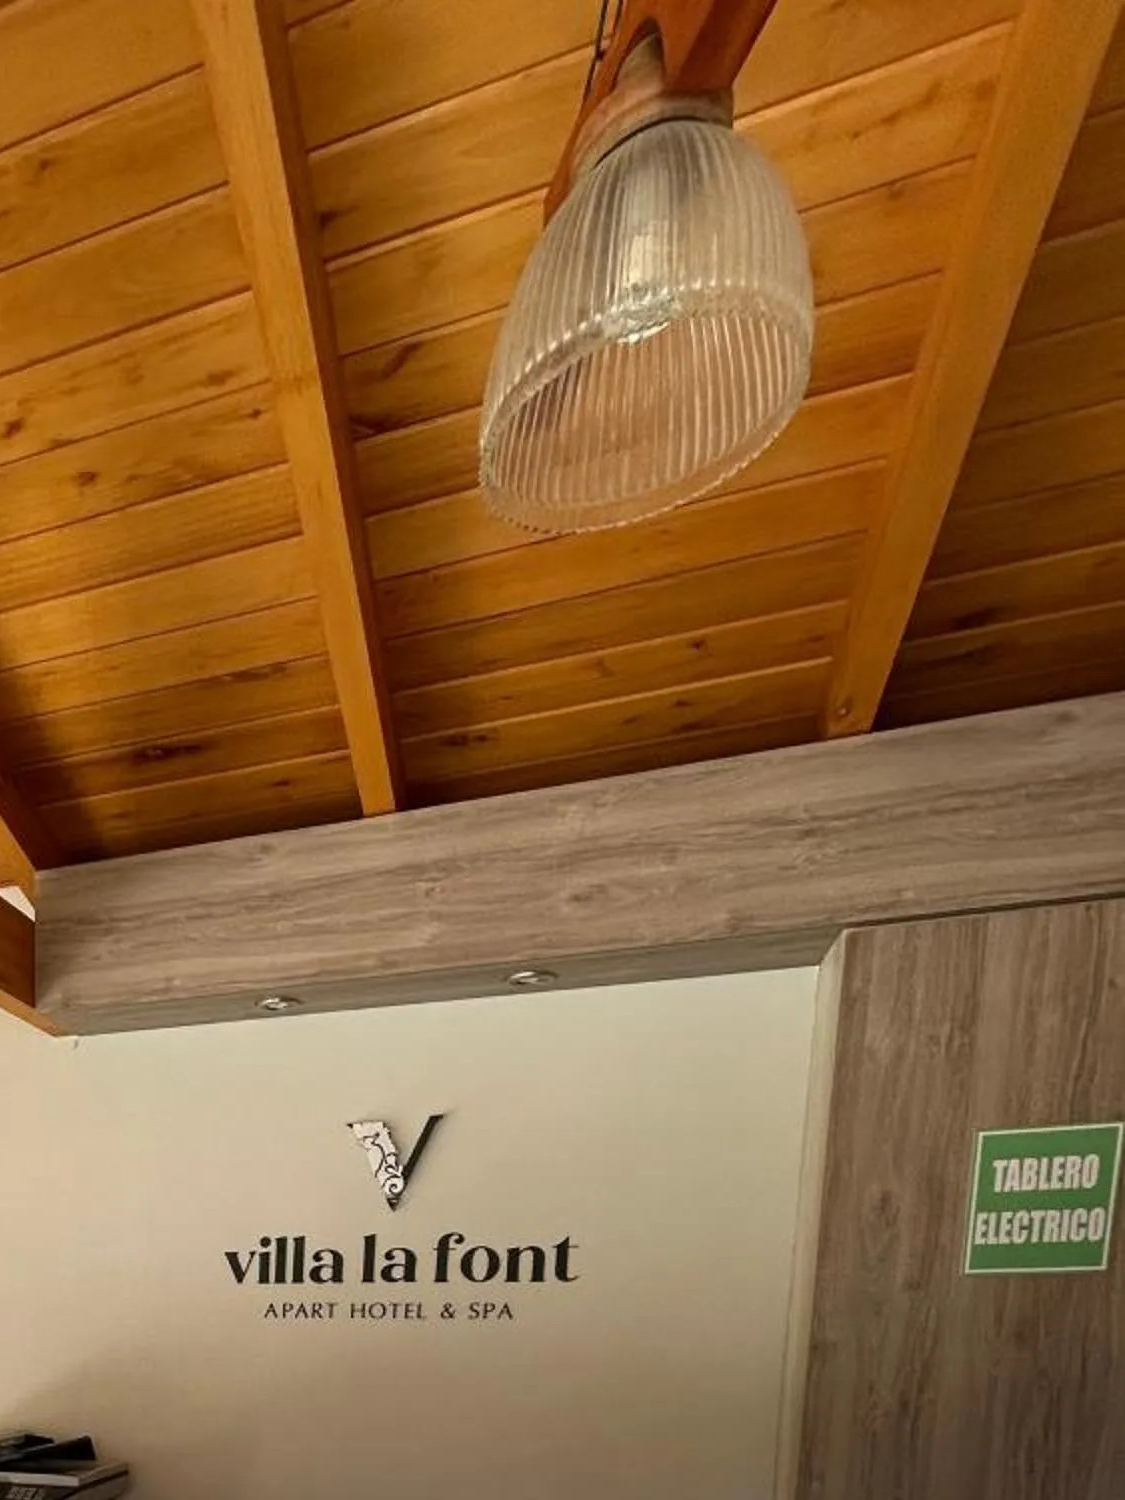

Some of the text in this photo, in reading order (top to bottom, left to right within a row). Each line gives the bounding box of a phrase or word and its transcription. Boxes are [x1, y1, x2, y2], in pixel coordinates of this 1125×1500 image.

[992, 1153, 1100, 1193] TABLERO
[974, 1207, 1106, 1245] ELECTRICO
[224, 1231, 582, 1284] villa la font
[264, 1301, 514, 1321] APART HOTEL & SPA
